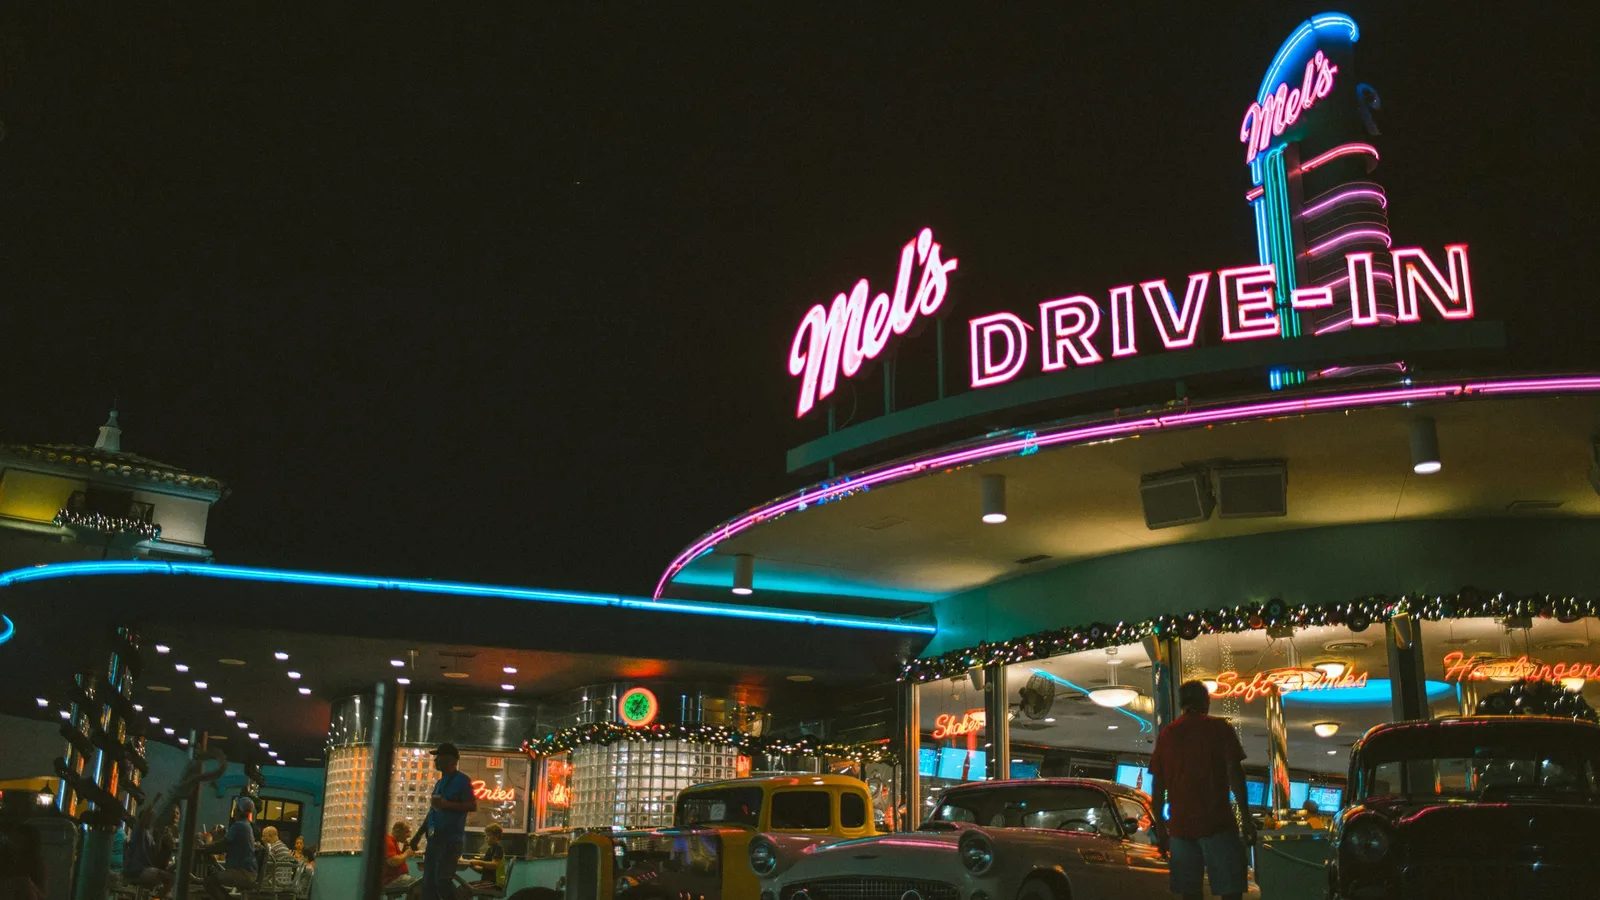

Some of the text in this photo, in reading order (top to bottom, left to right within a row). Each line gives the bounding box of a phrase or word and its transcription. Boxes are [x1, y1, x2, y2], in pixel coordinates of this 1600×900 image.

[1240, 50, 1338, 164] Mel's
[788, 227, 1475, 418] Mel's DRIVE-IN
[1208, 671, 1274, 702] Soft
[932, 712, 983, 739] Shakes
[471, 779, 516, 801] Fries
